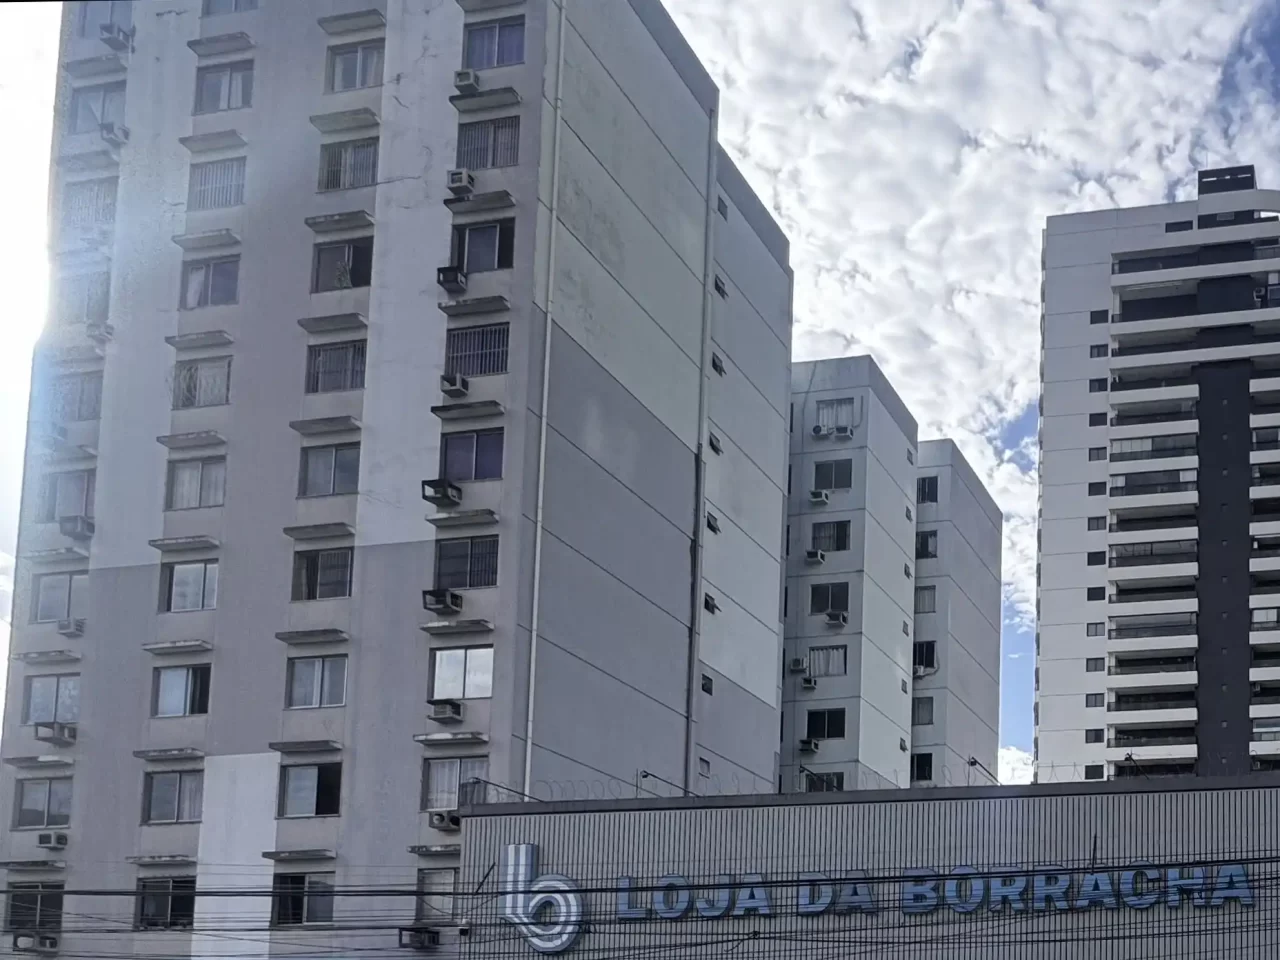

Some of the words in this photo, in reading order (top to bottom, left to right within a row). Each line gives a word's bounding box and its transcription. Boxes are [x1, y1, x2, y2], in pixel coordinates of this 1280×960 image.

[616, 873, 772, 921] LOJA
[797, 869, 877, 916] DA
[902, 861, 1256, 915] BORRACHA
